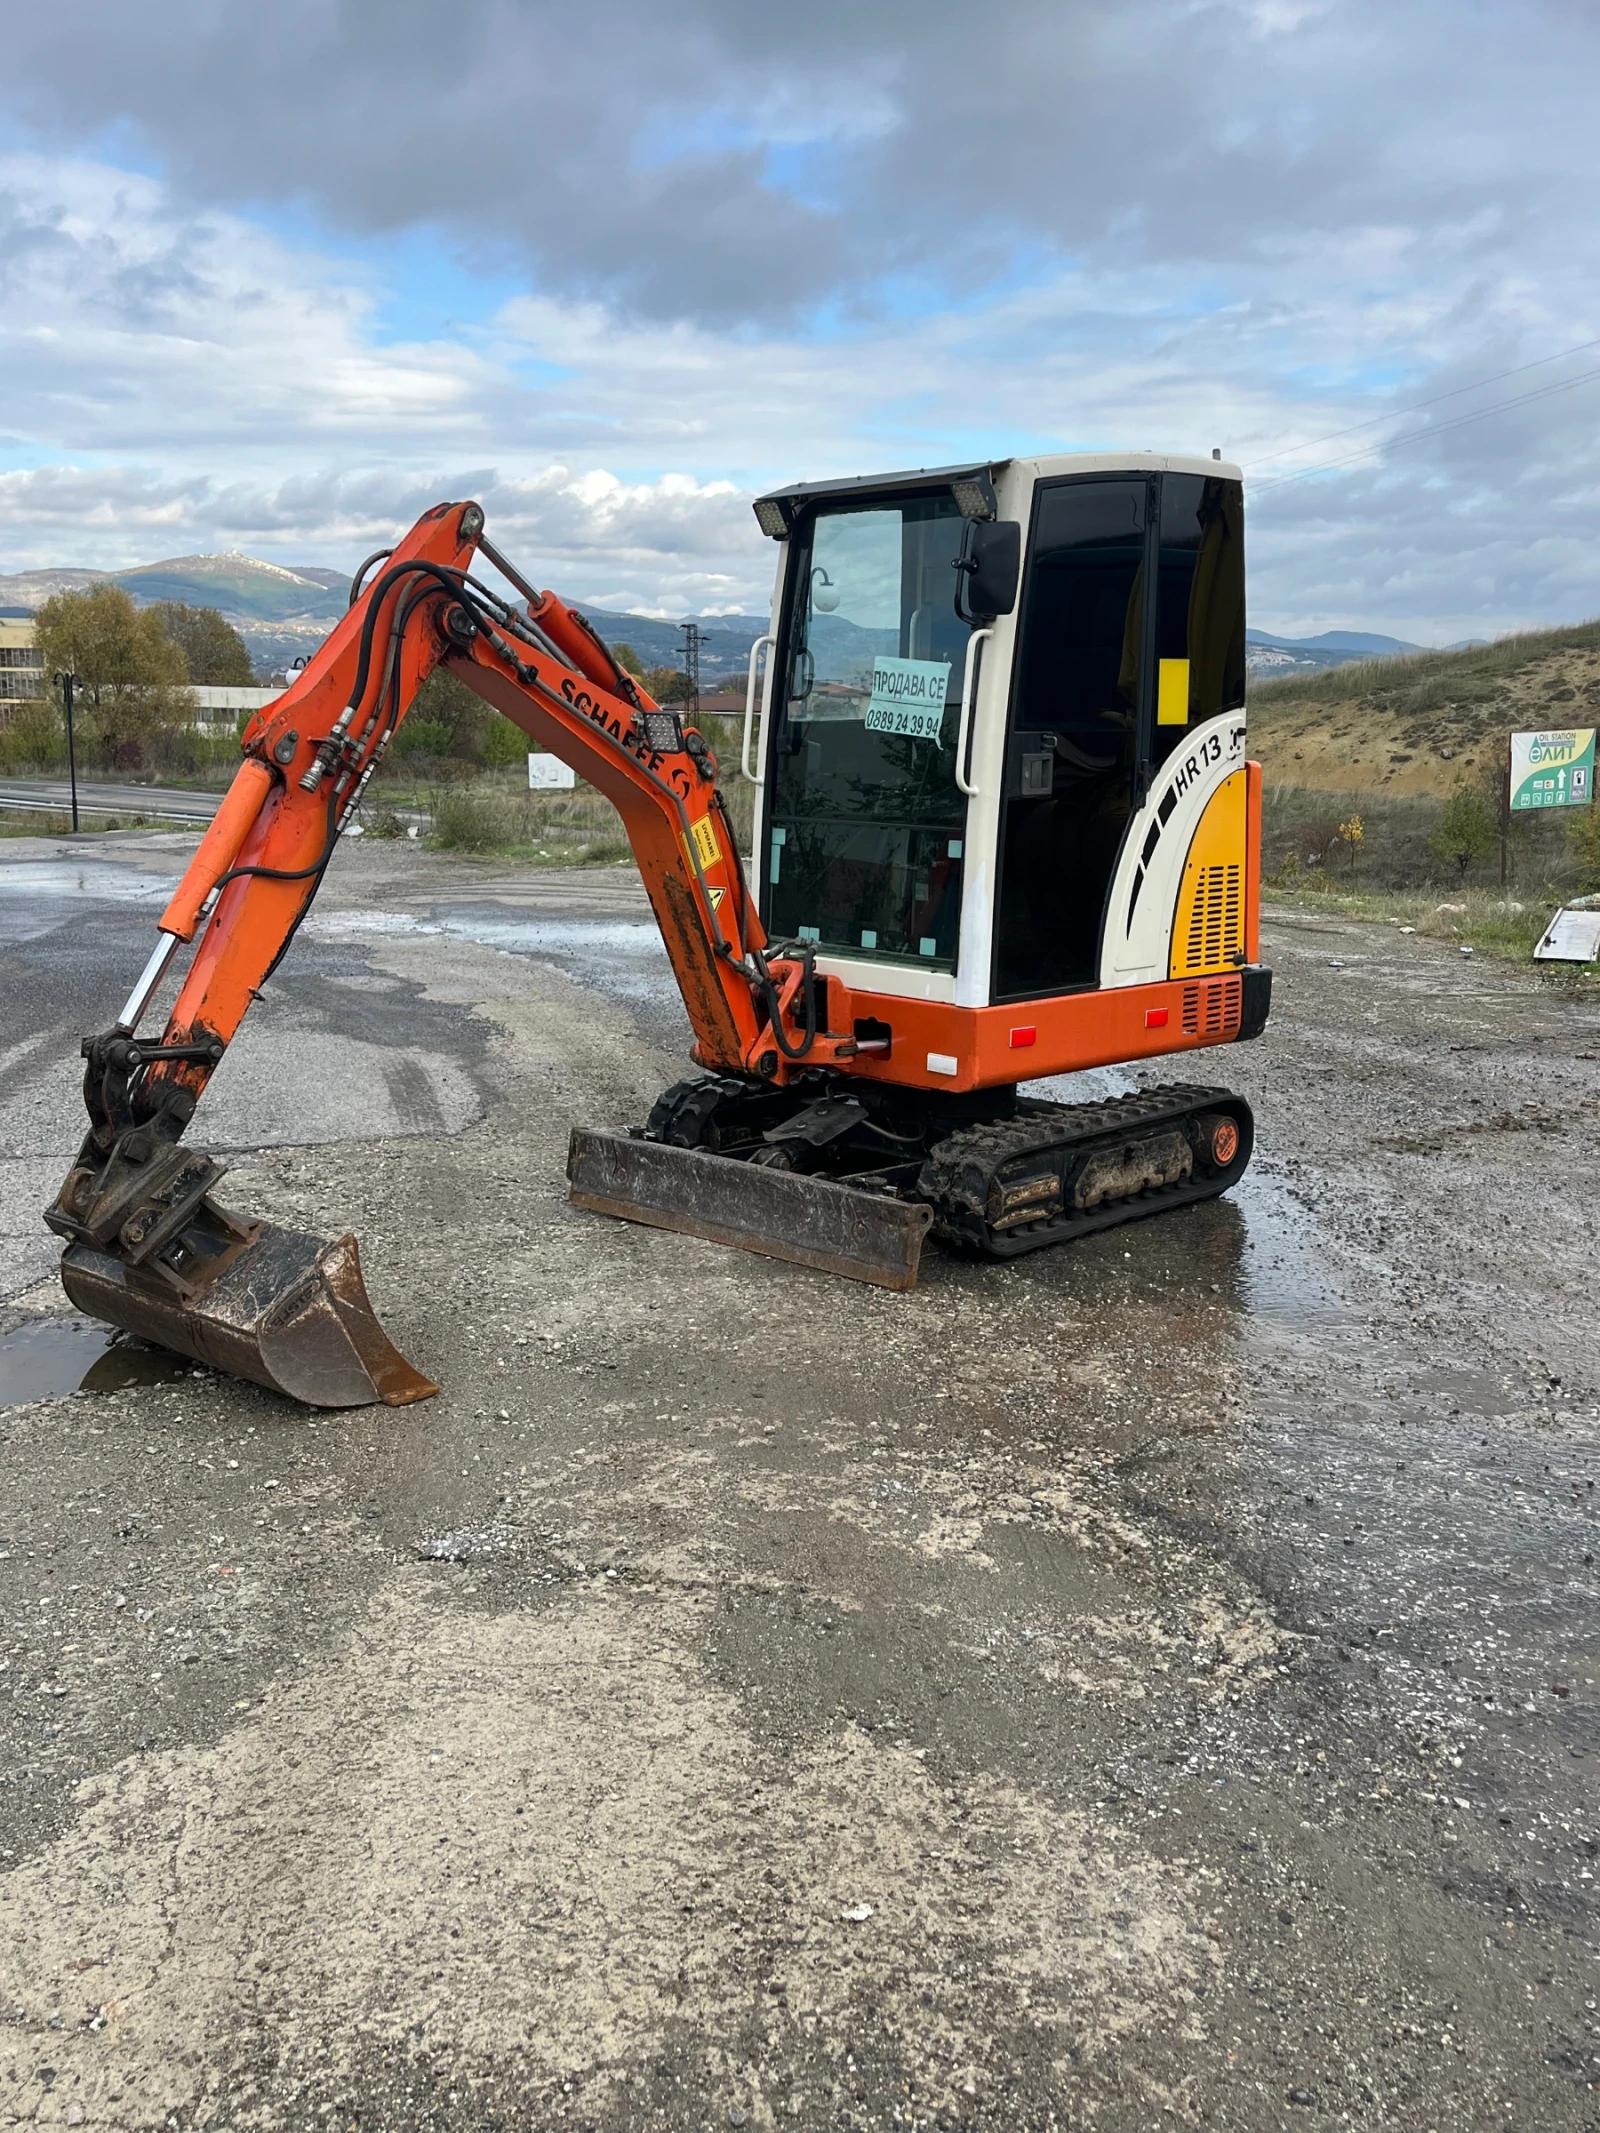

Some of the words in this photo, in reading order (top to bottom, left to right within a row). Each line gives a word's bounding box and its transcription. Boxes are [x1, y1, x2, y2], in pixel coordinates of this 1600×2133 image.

[873, 671, 925, 699] ПРОДАВА
[929, 677, 945, 699] СЕ
[866, 709, 894, 730] 0889
[895, 713, 908, 732] 24
[910, 715, 924, 735] 39
[925, 717, 939, 737] 94
[1539, 734, 1550, 742] OIL
[1551, 732, 1576, 741] STATION
[1175, 756, 1201, 798] HR
[1200, 734, 1222, 767] 13
